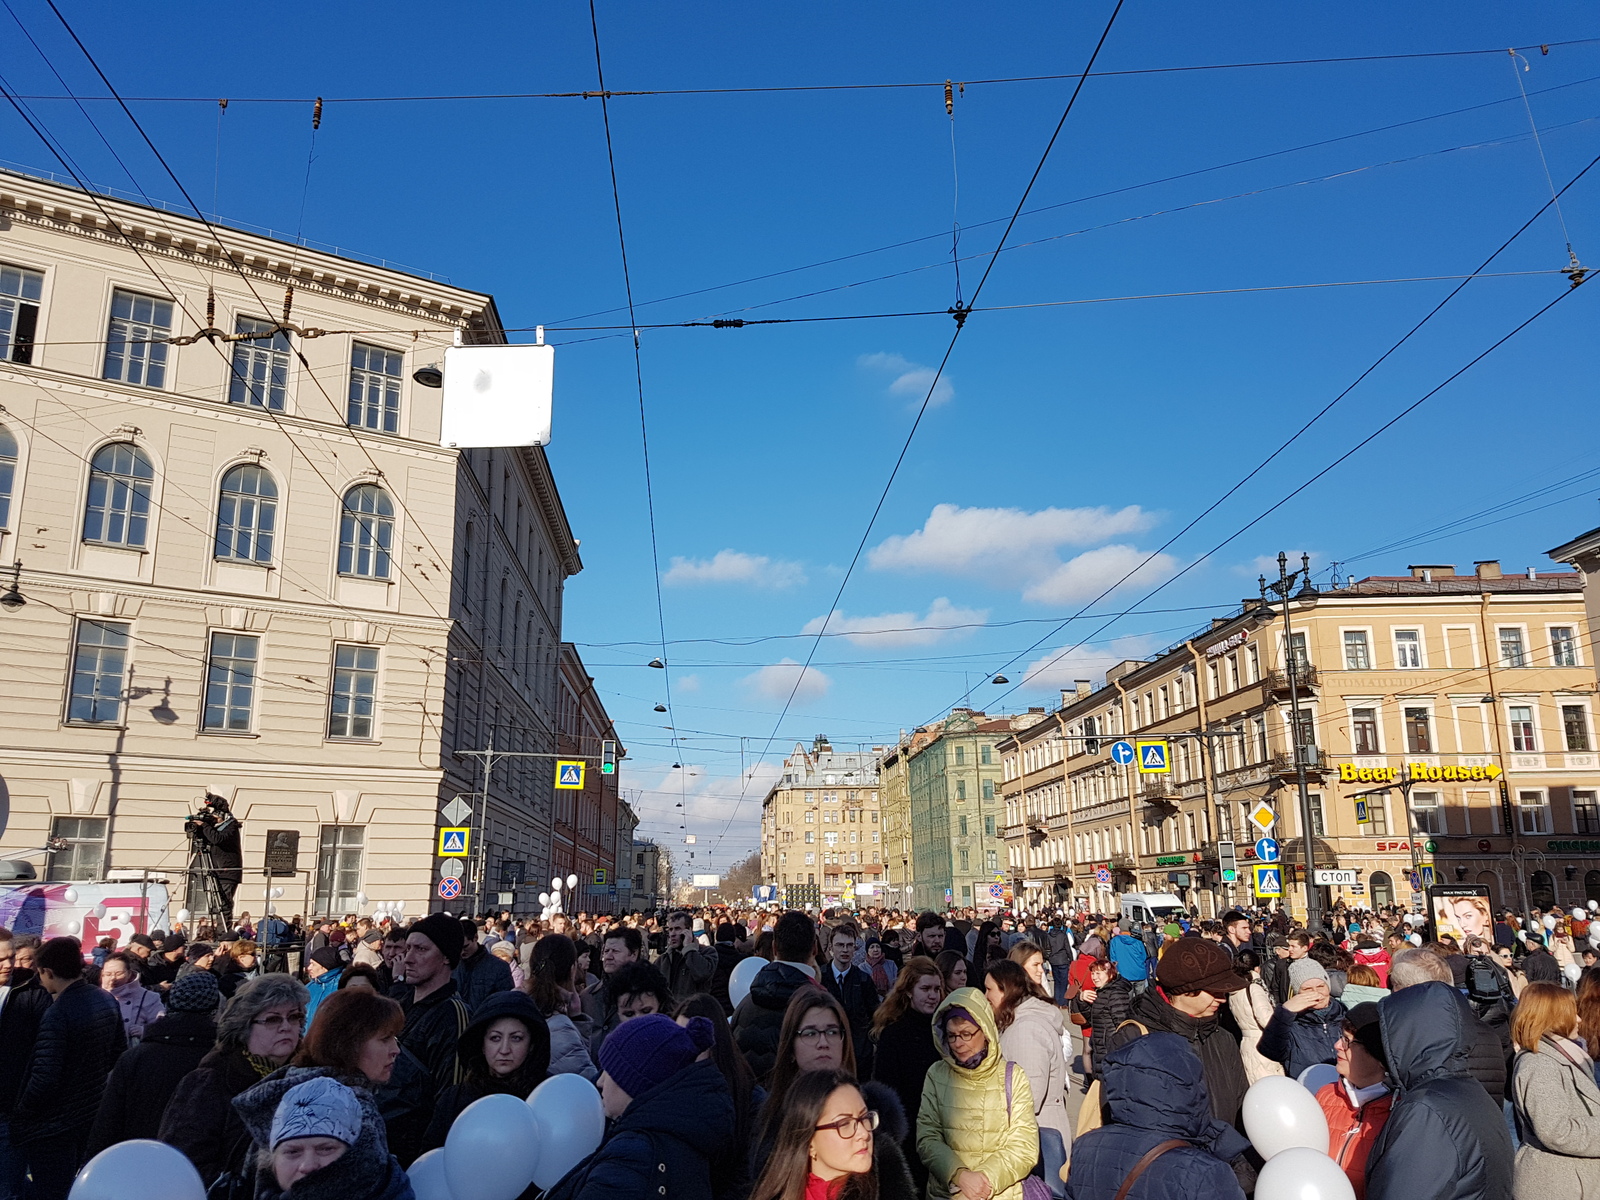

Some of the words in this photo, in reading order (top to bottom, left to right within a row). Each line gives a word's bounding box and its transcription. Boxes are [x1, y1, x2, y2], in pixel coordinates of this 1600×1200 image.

[1326, 677, 1443, 688] СТОМАТОЛОГИЯ
[1338, 763, 1398, 783] Beer
[1409, 762, 1486, 782] House
[1321, 872, 1351, 882] СТОП
[95, 906, 136, 948] 5
